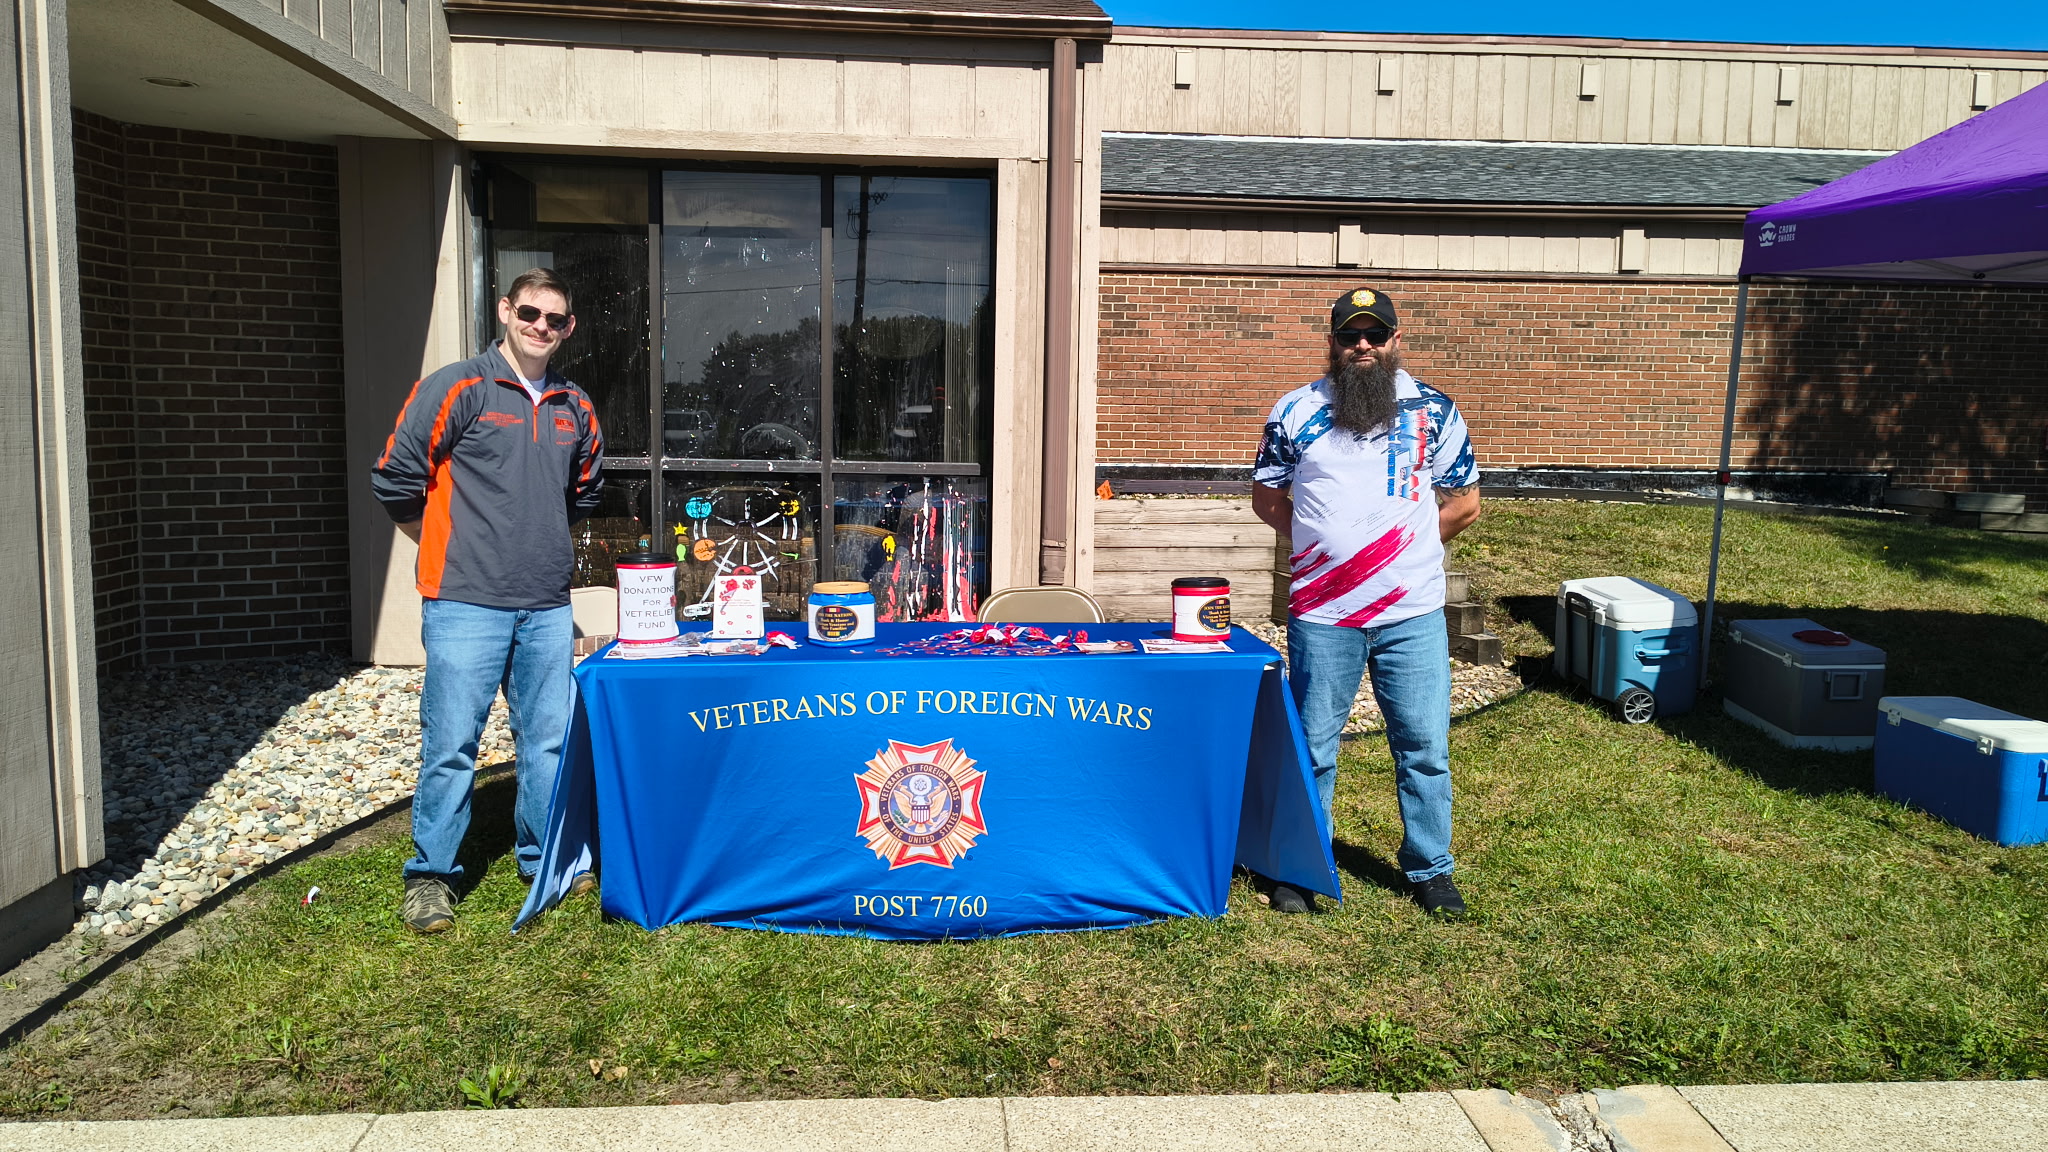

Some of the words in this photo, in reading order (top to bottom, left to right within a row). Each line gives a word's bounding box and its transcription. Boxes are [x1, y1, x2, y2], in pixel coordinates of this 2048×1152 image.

[1778, 224, 1796, 234] CROWN
[1778, 234, 1795, 242] SHADES
[625, 610, 643, 618] VET
[687, 692, 857, 733] VETERANS
[865, 690, 907, 715] OF
[916, 690, 1057, 719] FOREIGN
[1066, 696, 1153, 731] WARS
[880, 769, 905, 803] VETERANS
[906, 765, 917, 774] OF
[919, 764, 949, 781] FOREIGN
[947, 779, 961, 801] WARS
[882, 813, 891, 824] OF
[890, 825, 903, 839] THE
[908, 835, 935, 843] UNITED
[940, 811, 959, 837] STATES
[853, 895, 923, 917] POST
[930, 895, 988, 918] 7760
